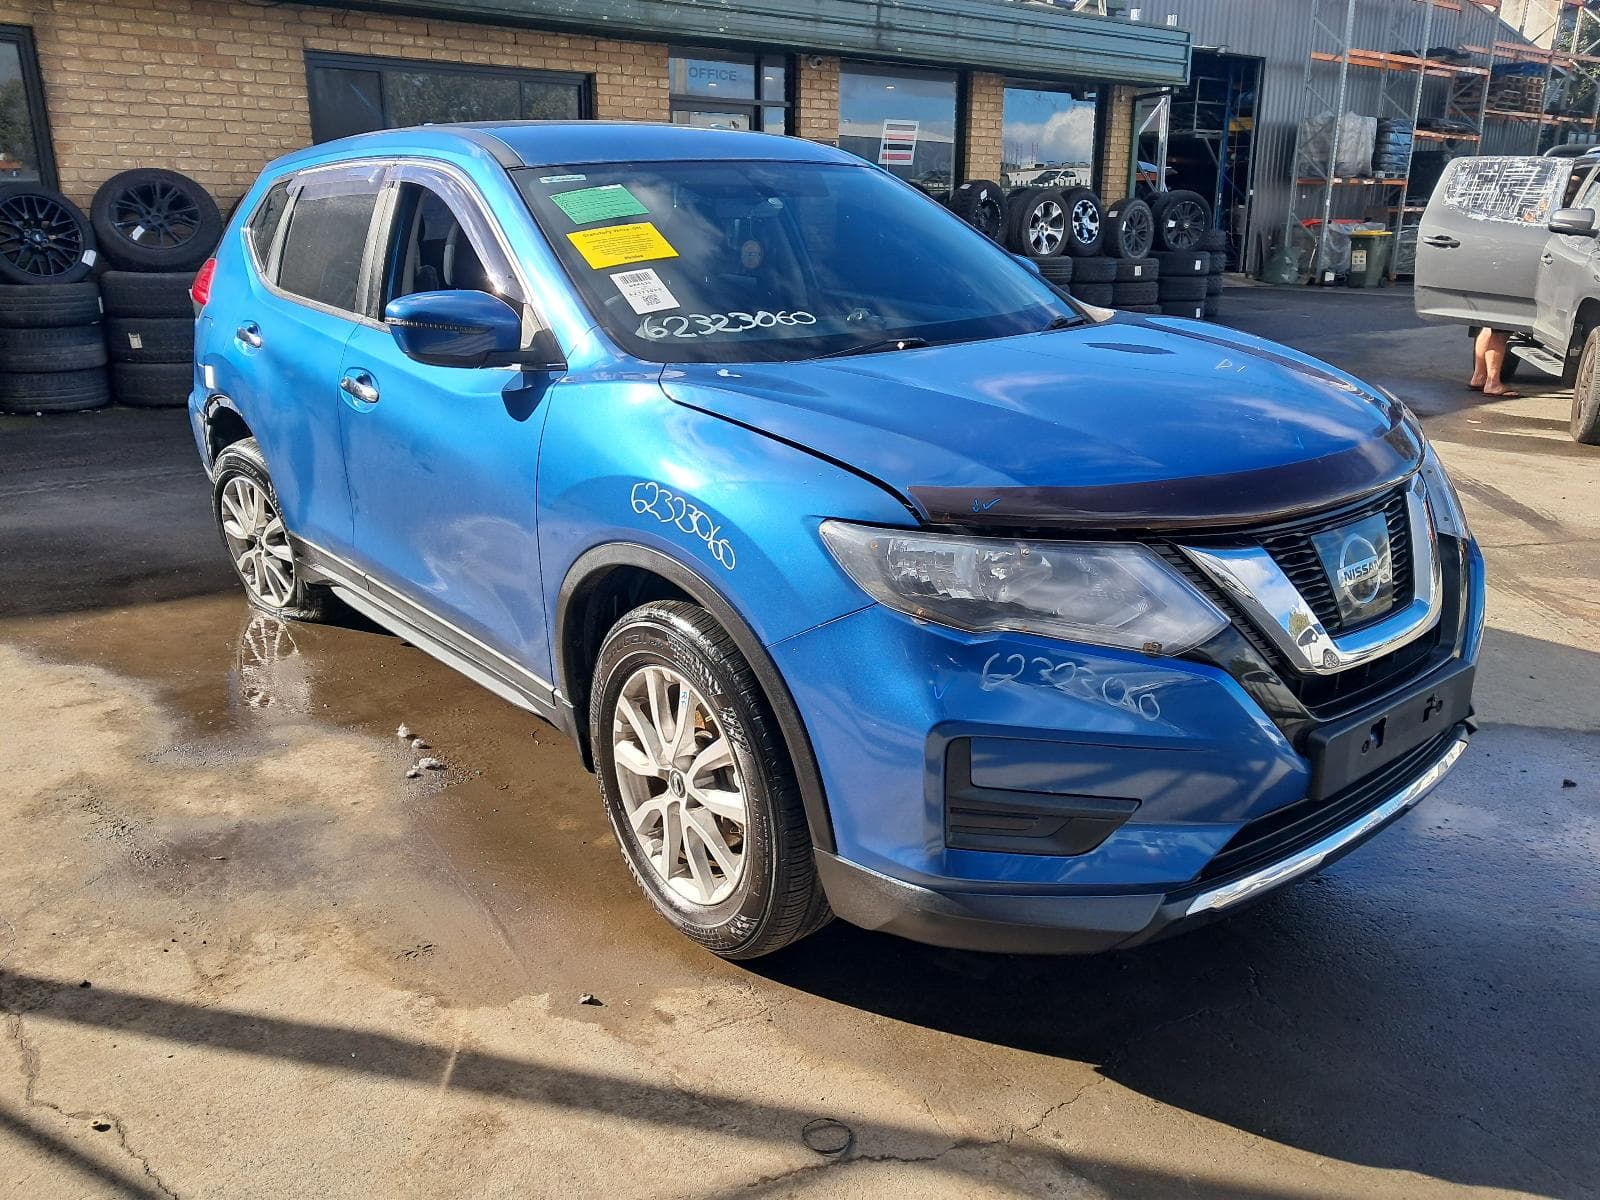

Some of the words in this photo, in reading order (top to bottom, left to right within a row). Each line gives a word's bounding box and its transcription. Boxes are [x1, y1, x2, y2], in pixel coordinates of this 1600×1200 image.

[688, 66, 737, 81] OFFICE
[643, 310, 817, 339] 62323060
[1343, 561, 1379, 581] NISSAN
